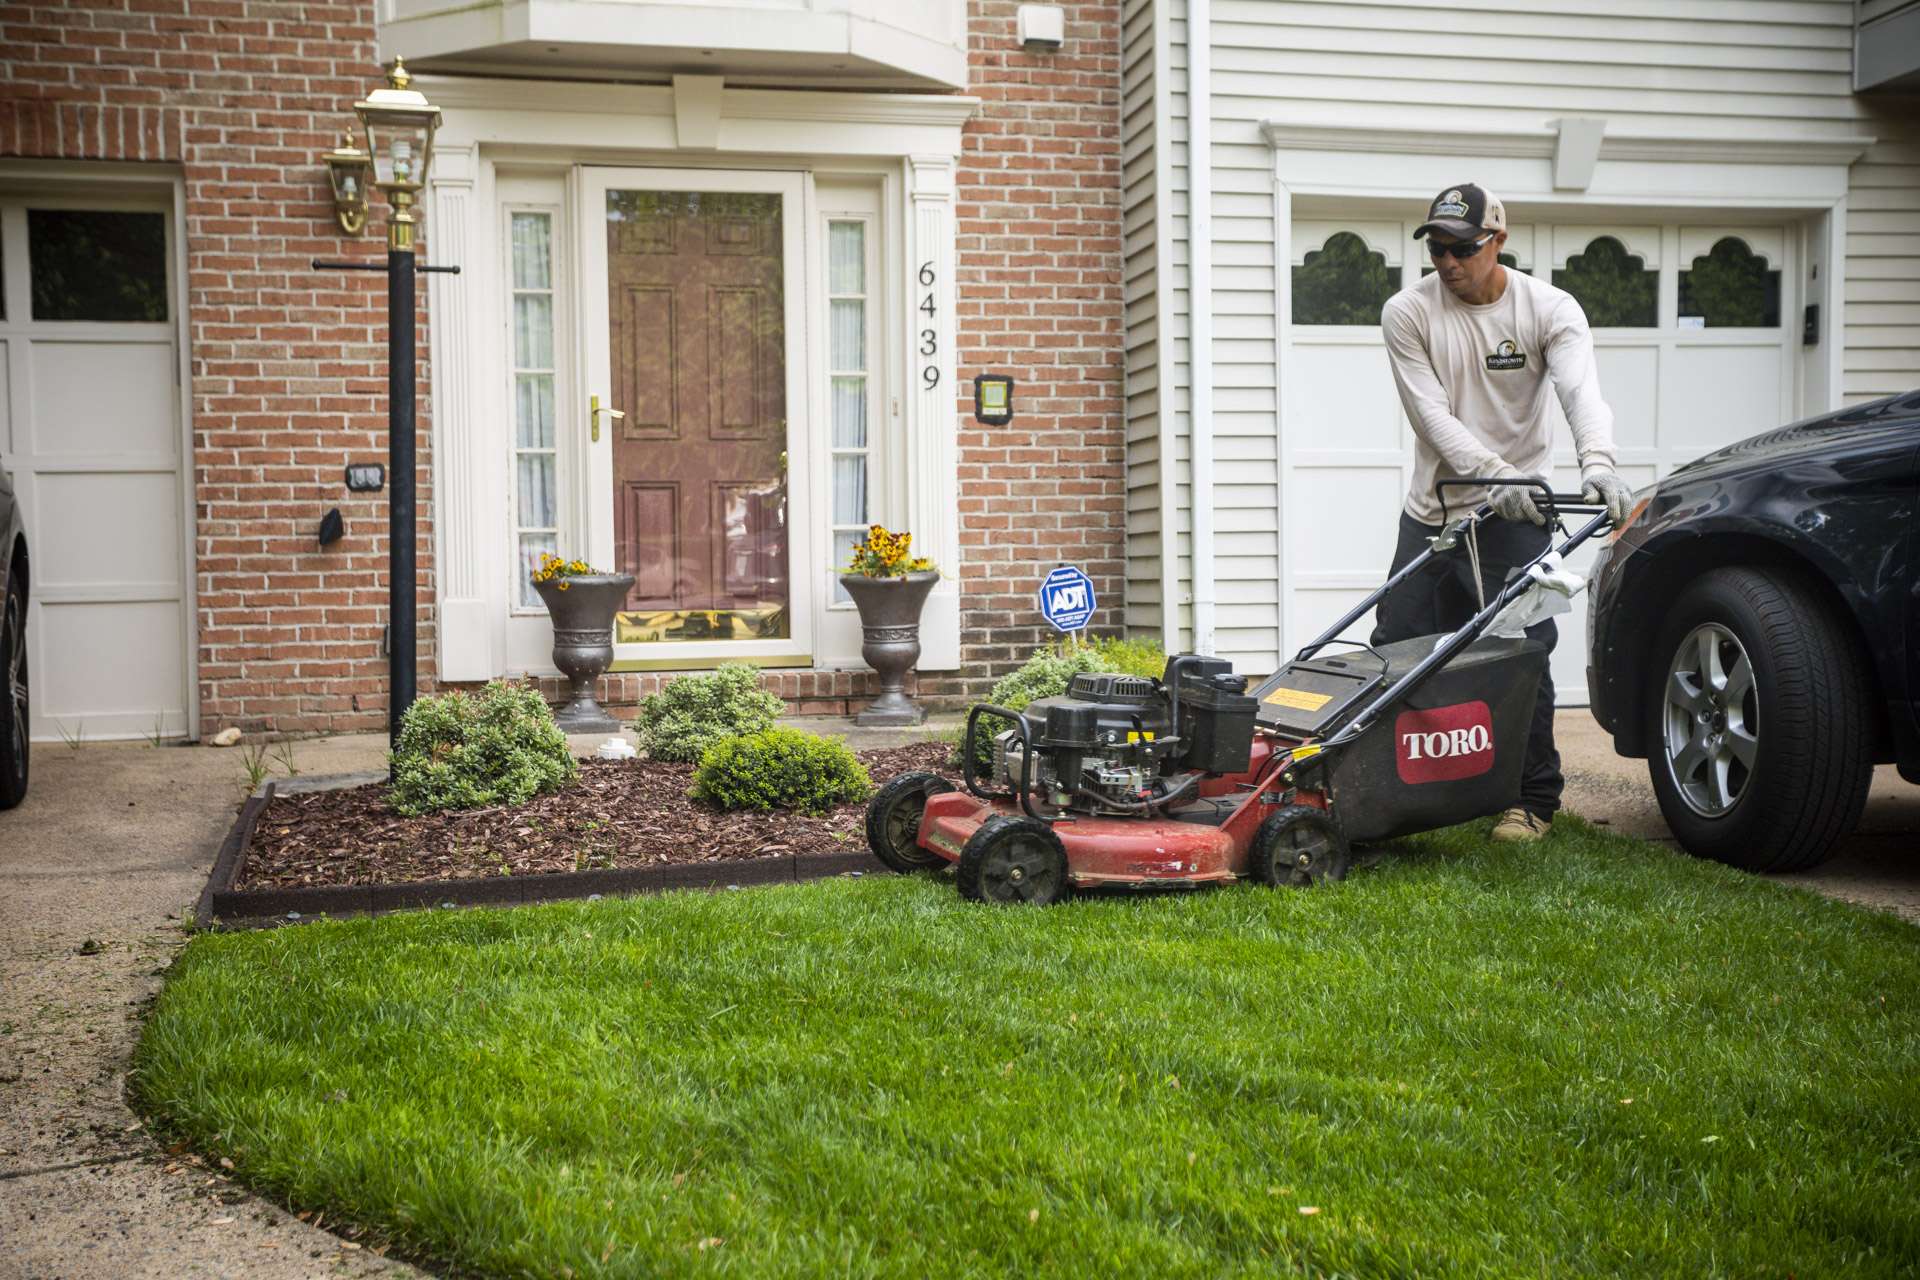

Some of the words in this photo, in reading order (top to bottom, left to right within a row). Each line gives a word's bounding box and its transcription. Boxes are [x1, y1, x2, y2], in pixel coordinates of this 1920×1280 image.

[919, 260, 940, 390] 6439
[1052, 586, 1086, 613] ADT
[1403, 725, 1489, 760] TORO
